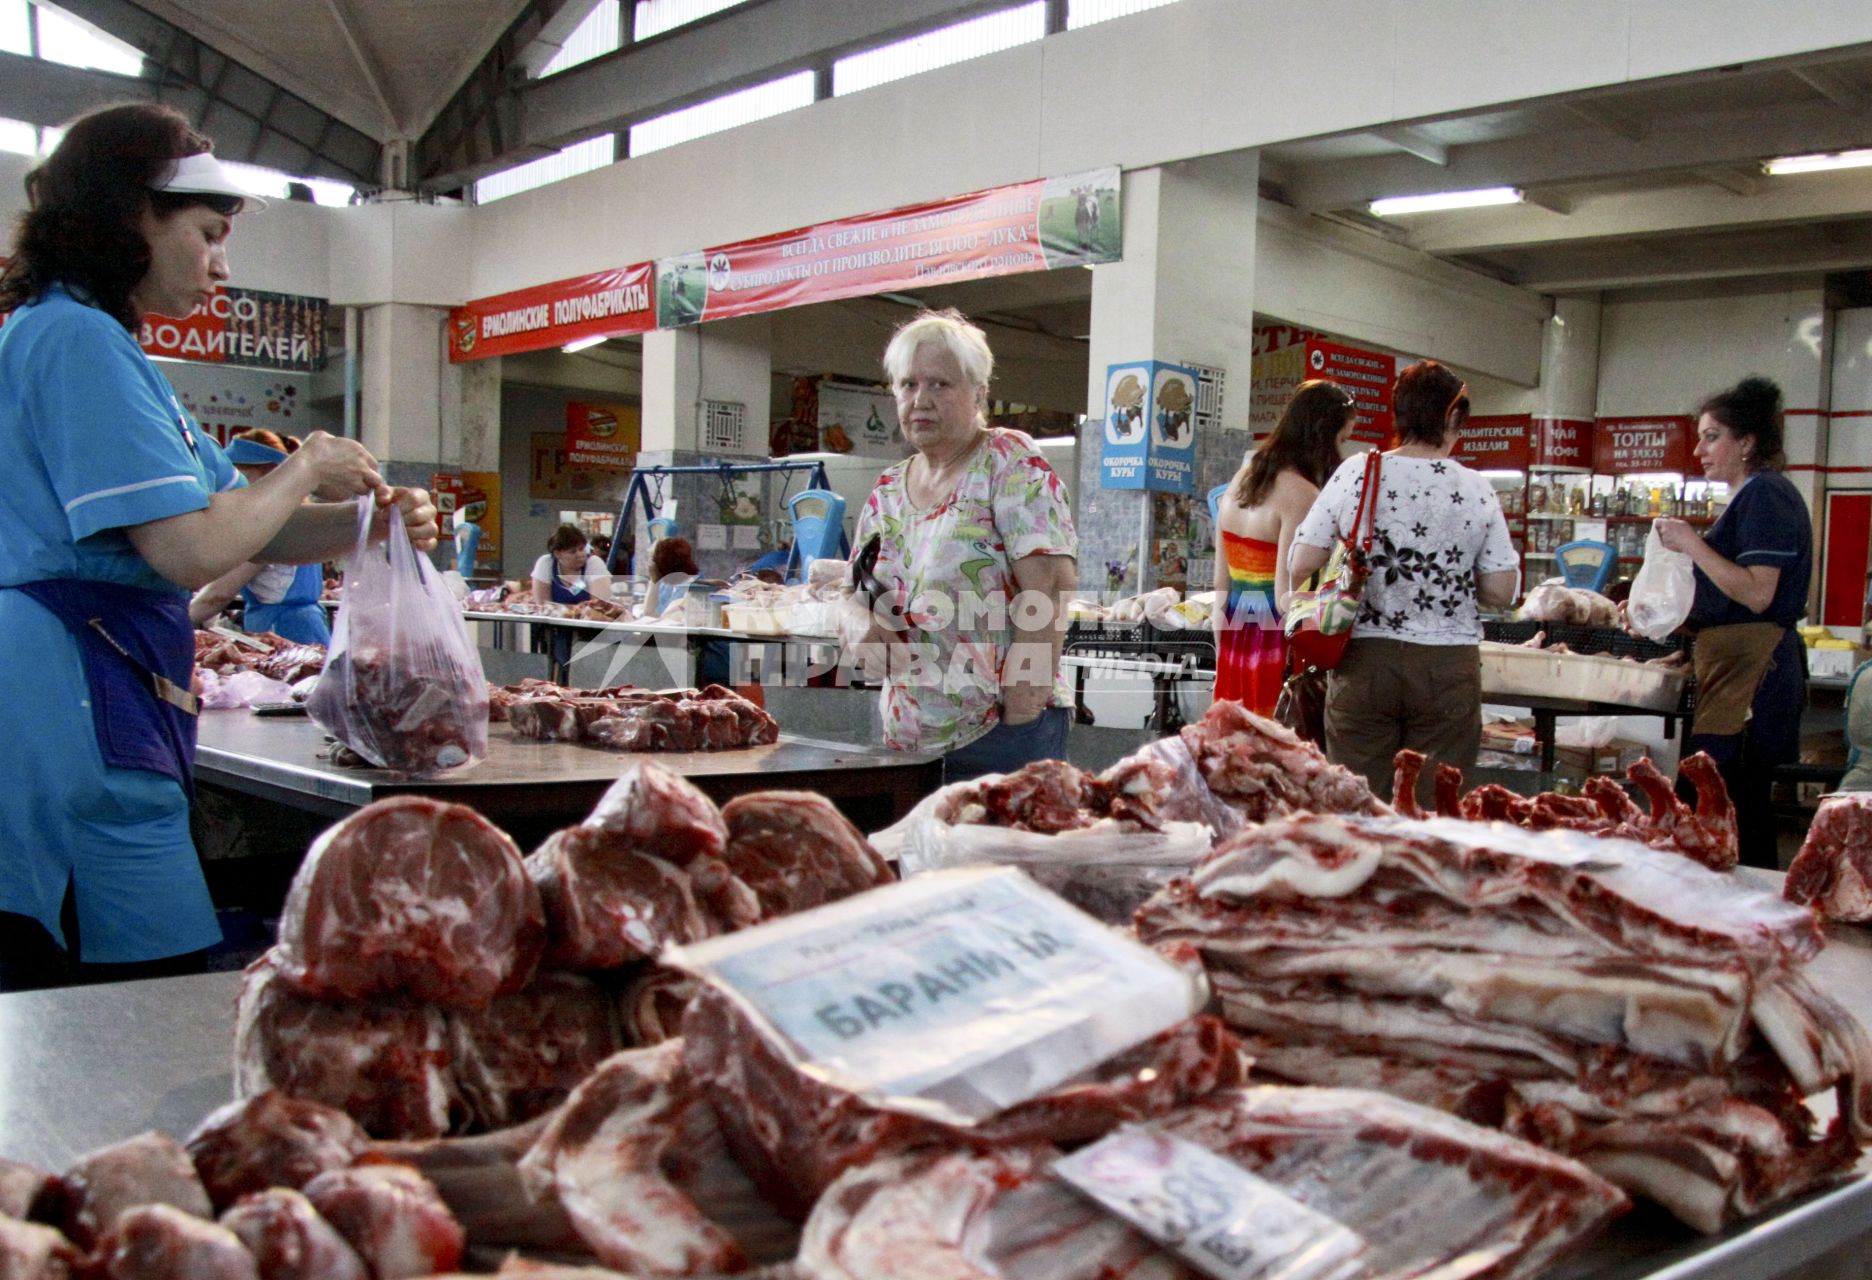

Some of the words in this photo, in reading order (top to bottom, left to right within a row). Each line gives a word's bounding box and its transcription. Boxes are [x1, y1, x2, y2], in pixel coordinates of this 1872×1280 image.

[782, 238, 825, 257] ВСЕГДА
[827, 227, 878, 249] СВЕЖИЕ
[892, 221, 911, 236] НЕ
[730, 263, 811, 292] СУБПРОДУКТЫ
[813, 260, 830, 276] ОТ
[832, 237, 943, 273] ПРОИЗВОДИТЕЛЯ
[482, 304, 550, 339] ЕРМОЛИНСКИЕ
[554, 284, 650, 327] ПОЛУФАБРИКАТЫ
[133, 323, 309, 363] ВОДИТЕЛЕЙ
[1458, 426, 1524, 438] ОНДИТЕРСКИЕ
[1551, 428, 1577, 440] ЧАЙ
[575, 439, 629, 453] ЕРМОЛИНСКИЕ
[1463, 441, 1510, 452] ИЗДЕЛИЯ
[1612, 432, 1667, 448] ТОРТЫ
[1544, 446, 1580, 458] КОФЕ
[1614, 449, 1628, 459] НА
[1631, 449, 1665, 459] ЗАКАЗ
[1103, 456, 1143, 467] ОКОРОЧКА
[1148, 458, 1191, 473] ОКОРОЧКА
[1110, 467, 1135, 478] КУРЫ
[1155, 469, 1182, 482] КУРЫ
